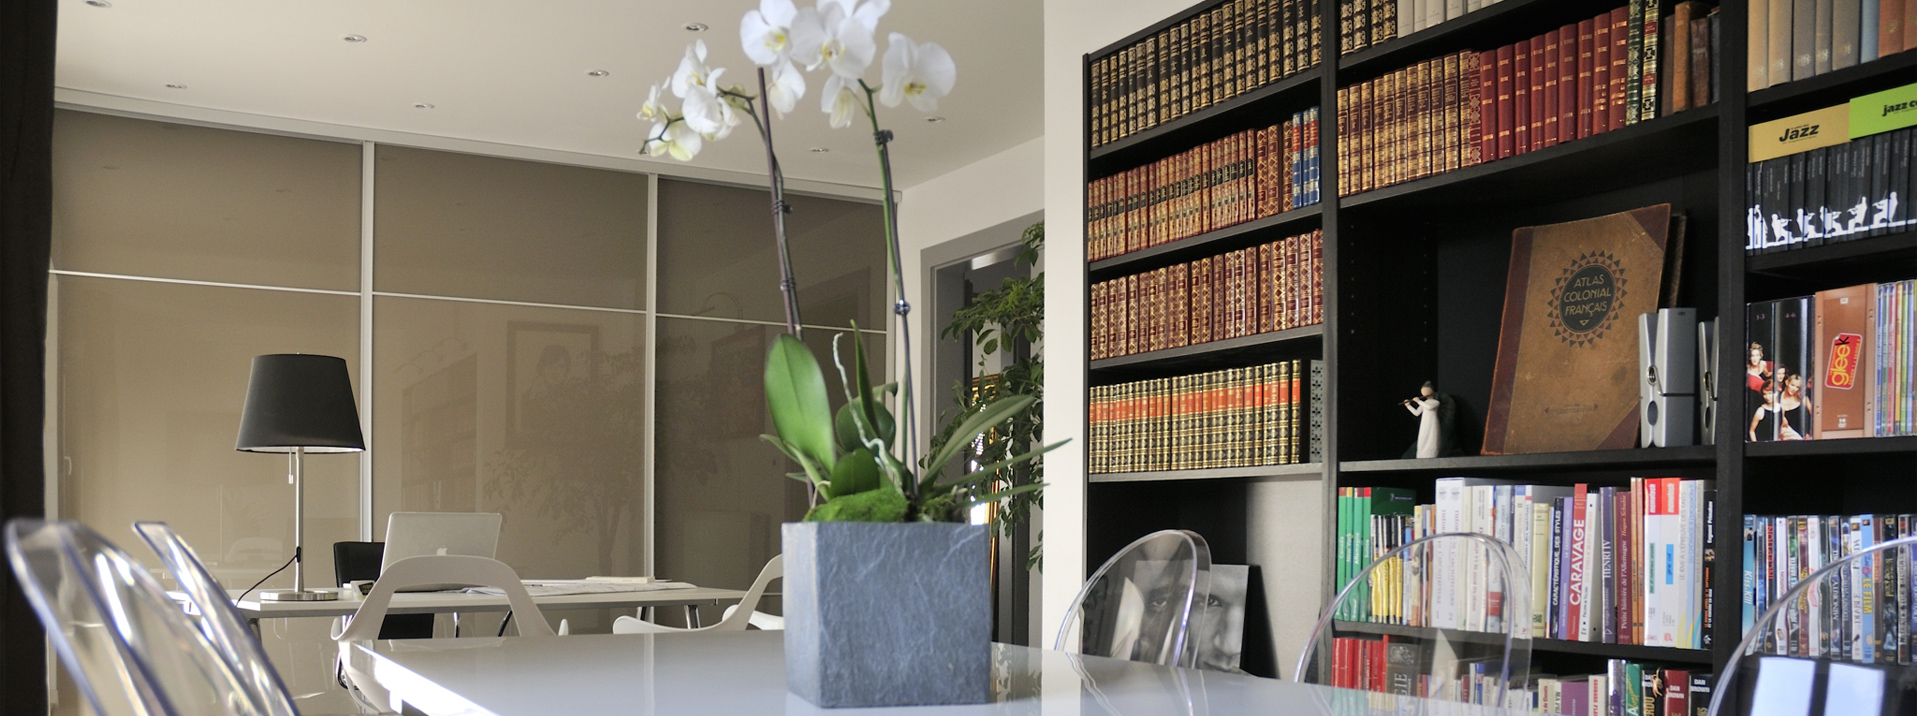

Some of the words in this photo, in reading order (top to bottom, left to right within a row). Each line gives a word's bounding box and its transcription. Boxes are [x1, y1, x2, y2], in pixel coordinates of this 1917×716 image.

[1882, 101, 1908, 117] jazz
[1779, 124, 1820, 142] Jazz
[1573, 274, 1605, 288] ATLAS
[1563, 287, 1612, 303] COLONIAL
[1564, 301, 1608, 317] FRANÇAIS
[1603, 539, 1610, 549] IV
[1766, 525, 1775, 579] INCEPTION
[1569, 519, 1585, 605] CARAVAGE
[1603, 550, 1611, 578] HENRI
[1552, 551, 1561, 606] CARACTÉRISTIQUE
[1862, 578, 1872, 589] LE
[1853, 594, 1861, 624] DIABLE
[1862, 591, 1872, 613] FILM
